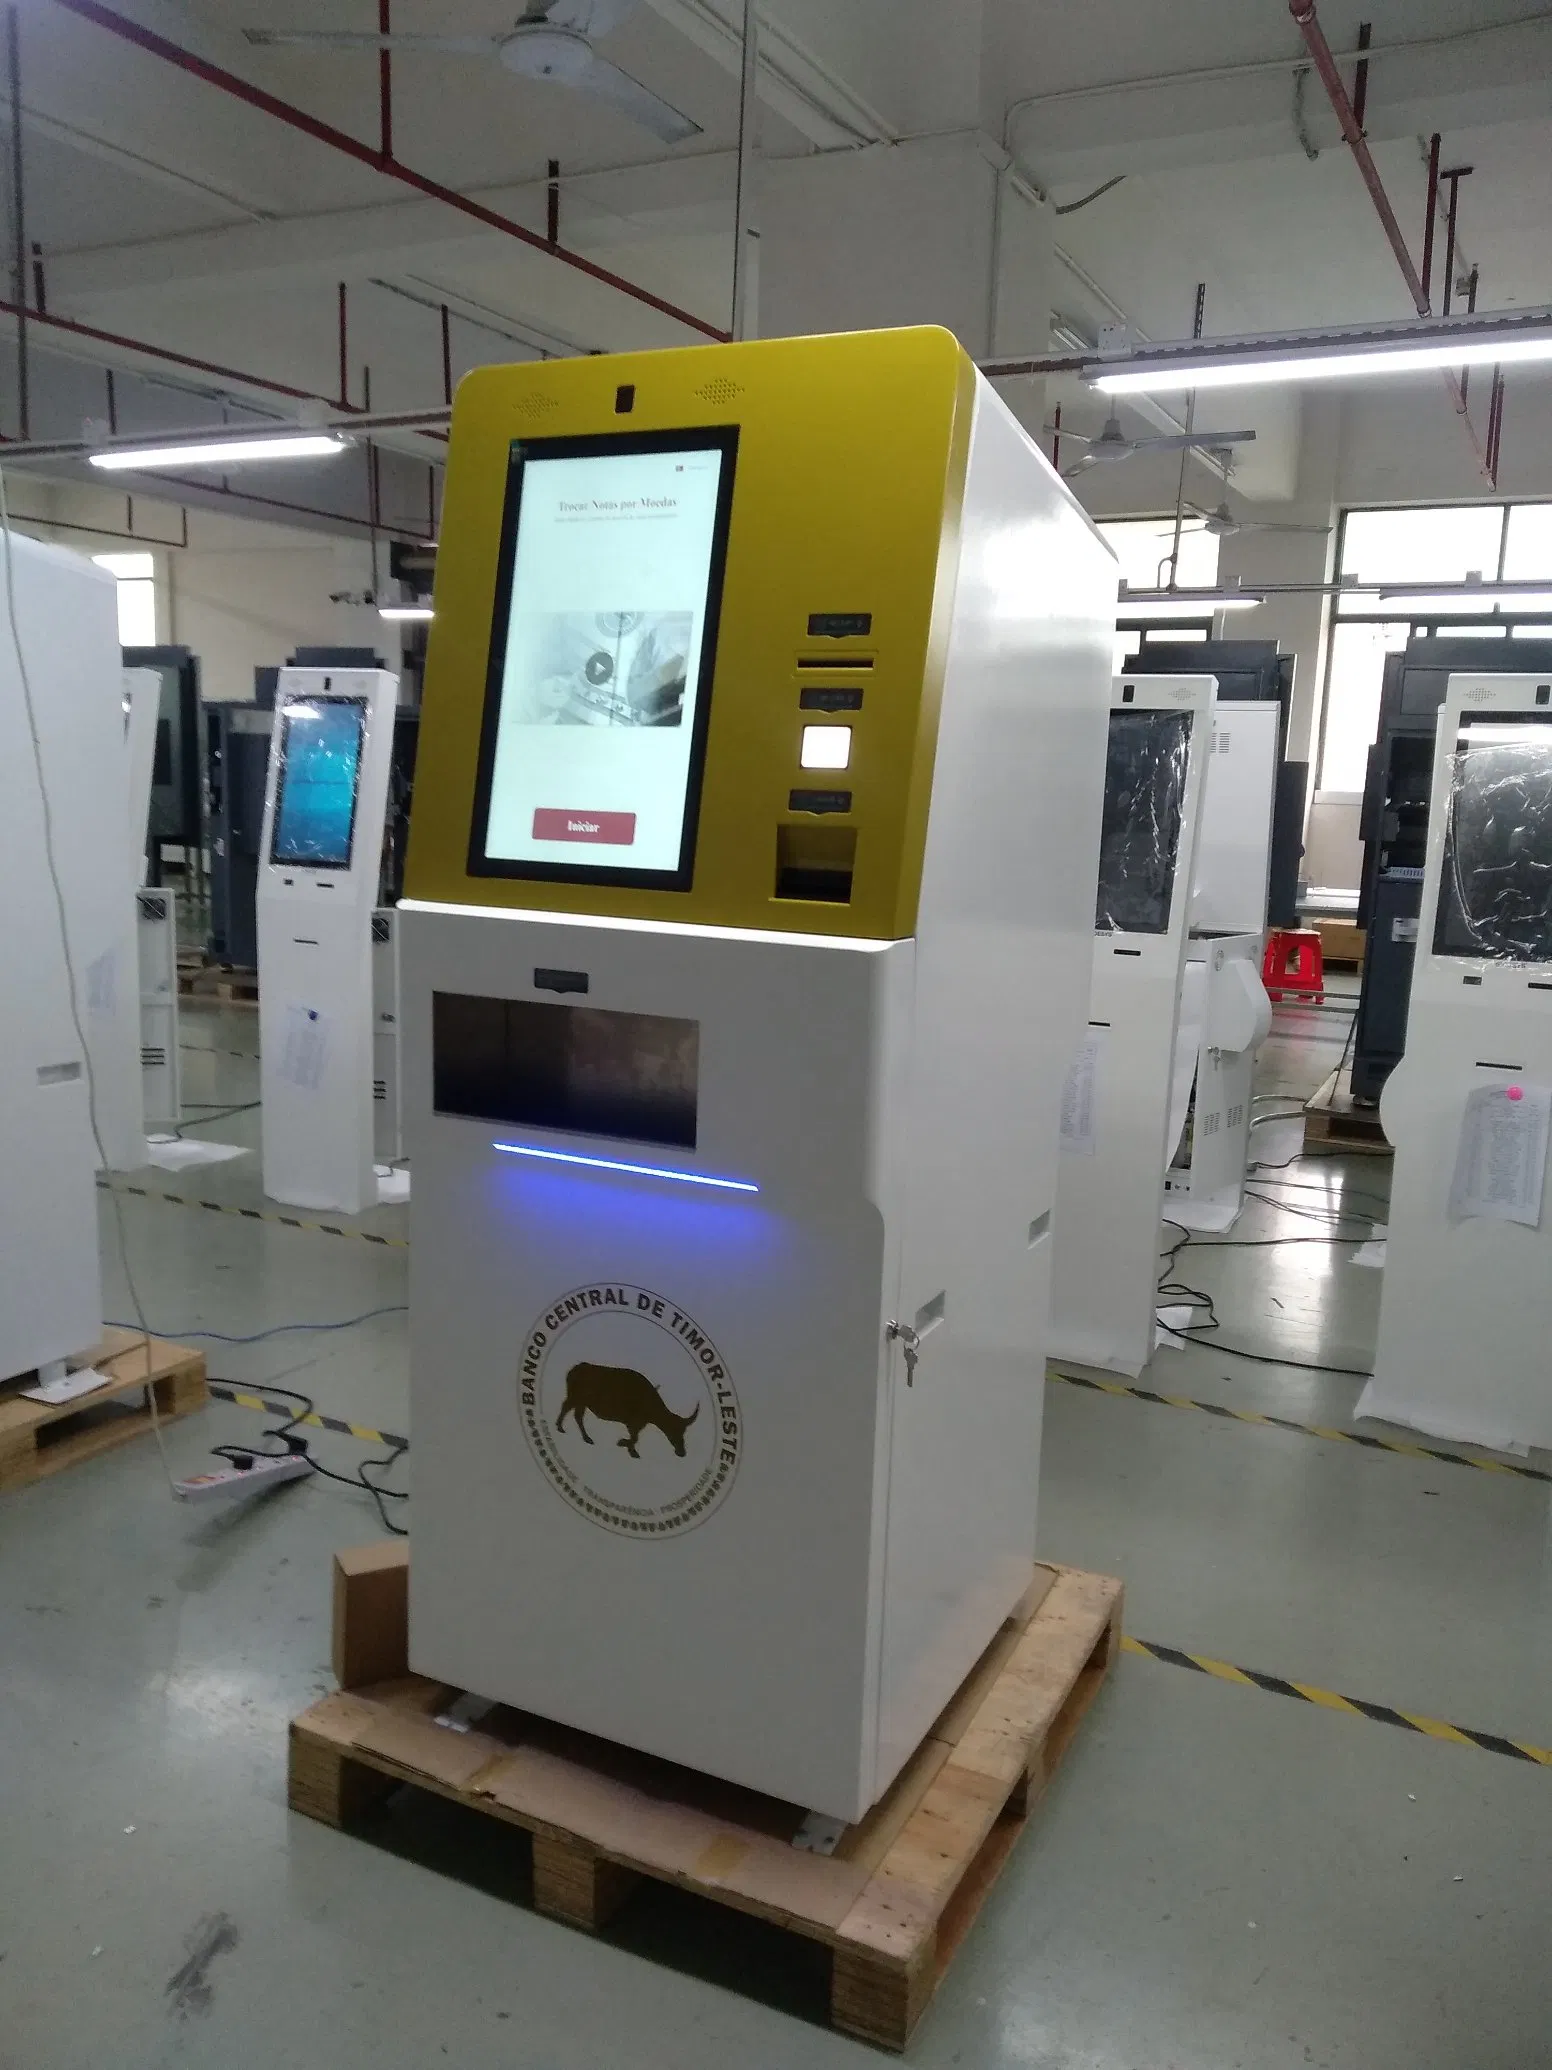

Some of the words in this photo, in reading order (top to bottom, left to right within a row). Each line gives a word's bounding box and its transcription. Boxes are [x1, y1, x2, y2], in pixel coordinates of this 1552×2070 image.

[558, 500, 589, 512] Trocar
[592, 499, 619, 510] Notas
[620, 500, 637, 512] por
[640, 496, 679, 509] Moedas
[567, 820, 600, 833] Iniciar
[522, 1331, 547, 1406] BANCO
[545, 1287, 629, 1331] CENTRAL
[637, 1292, 665, 1319] DE
[669, 1310, 739, 1466] TIMOR-LESTE
